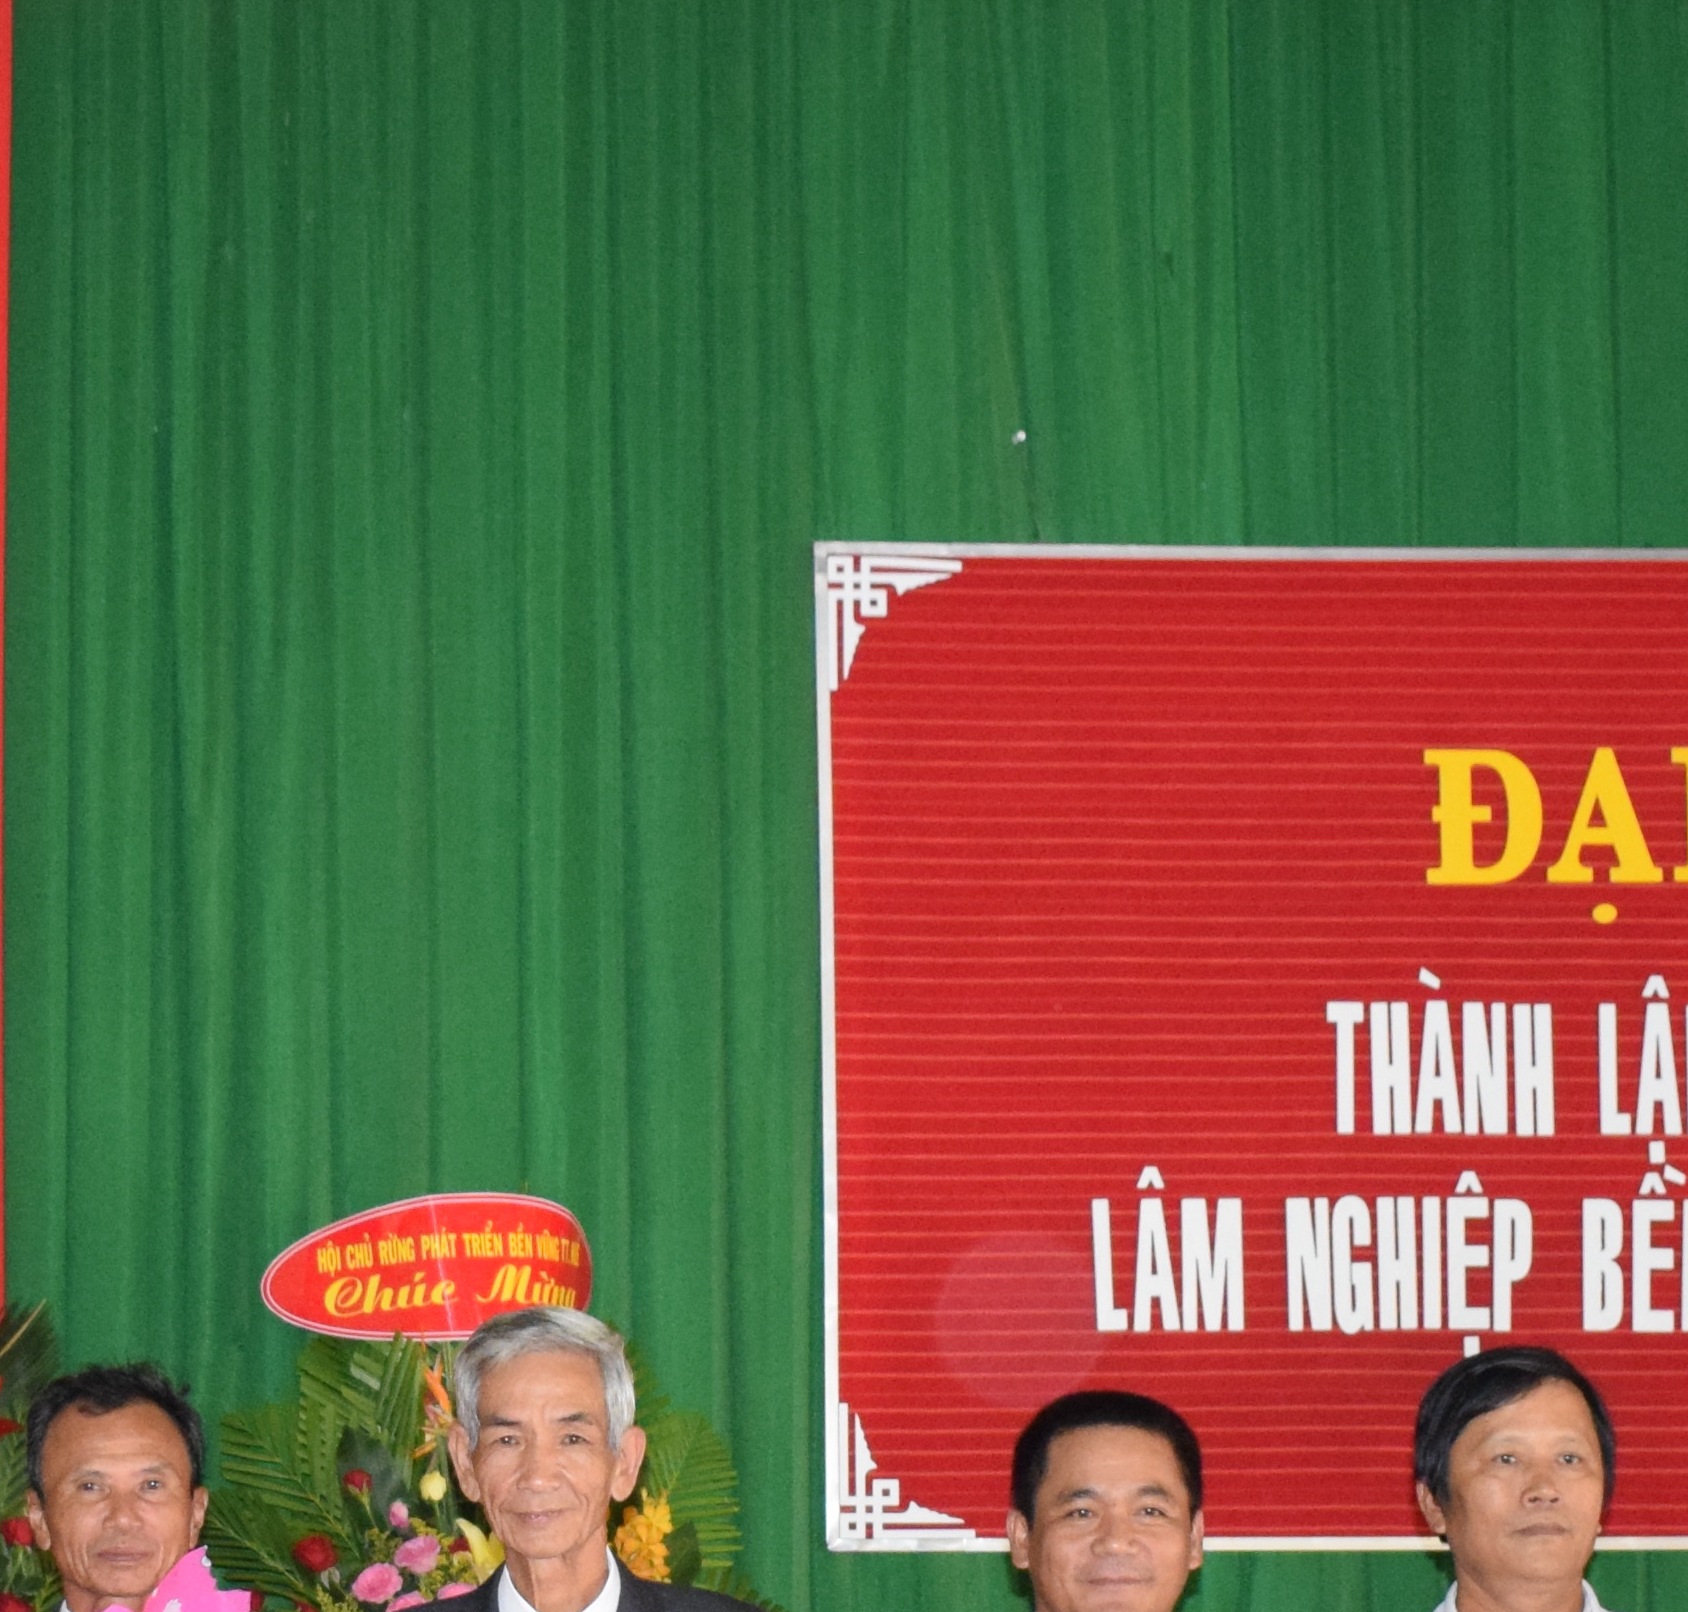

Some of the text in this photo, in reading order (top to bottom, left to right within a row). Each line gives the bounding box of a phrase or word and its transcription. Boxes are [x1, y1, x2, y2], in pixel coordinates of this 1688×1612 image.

[1325, 966, 1555, 1138] THÀNH
[317, 1240, 342, 1277] HỘI
[346, 1232, 374, 1270] CHỦ
[378, 1232, 416, 1266] RỪNG
[420, 1226, 458, 1260] PHÁT
[324, 1271, 459, 1318] Chúc
[1091, 1165, 1245, 1334] LÂM
[1285, 1169, 1533, 1358] NGHIỆP
